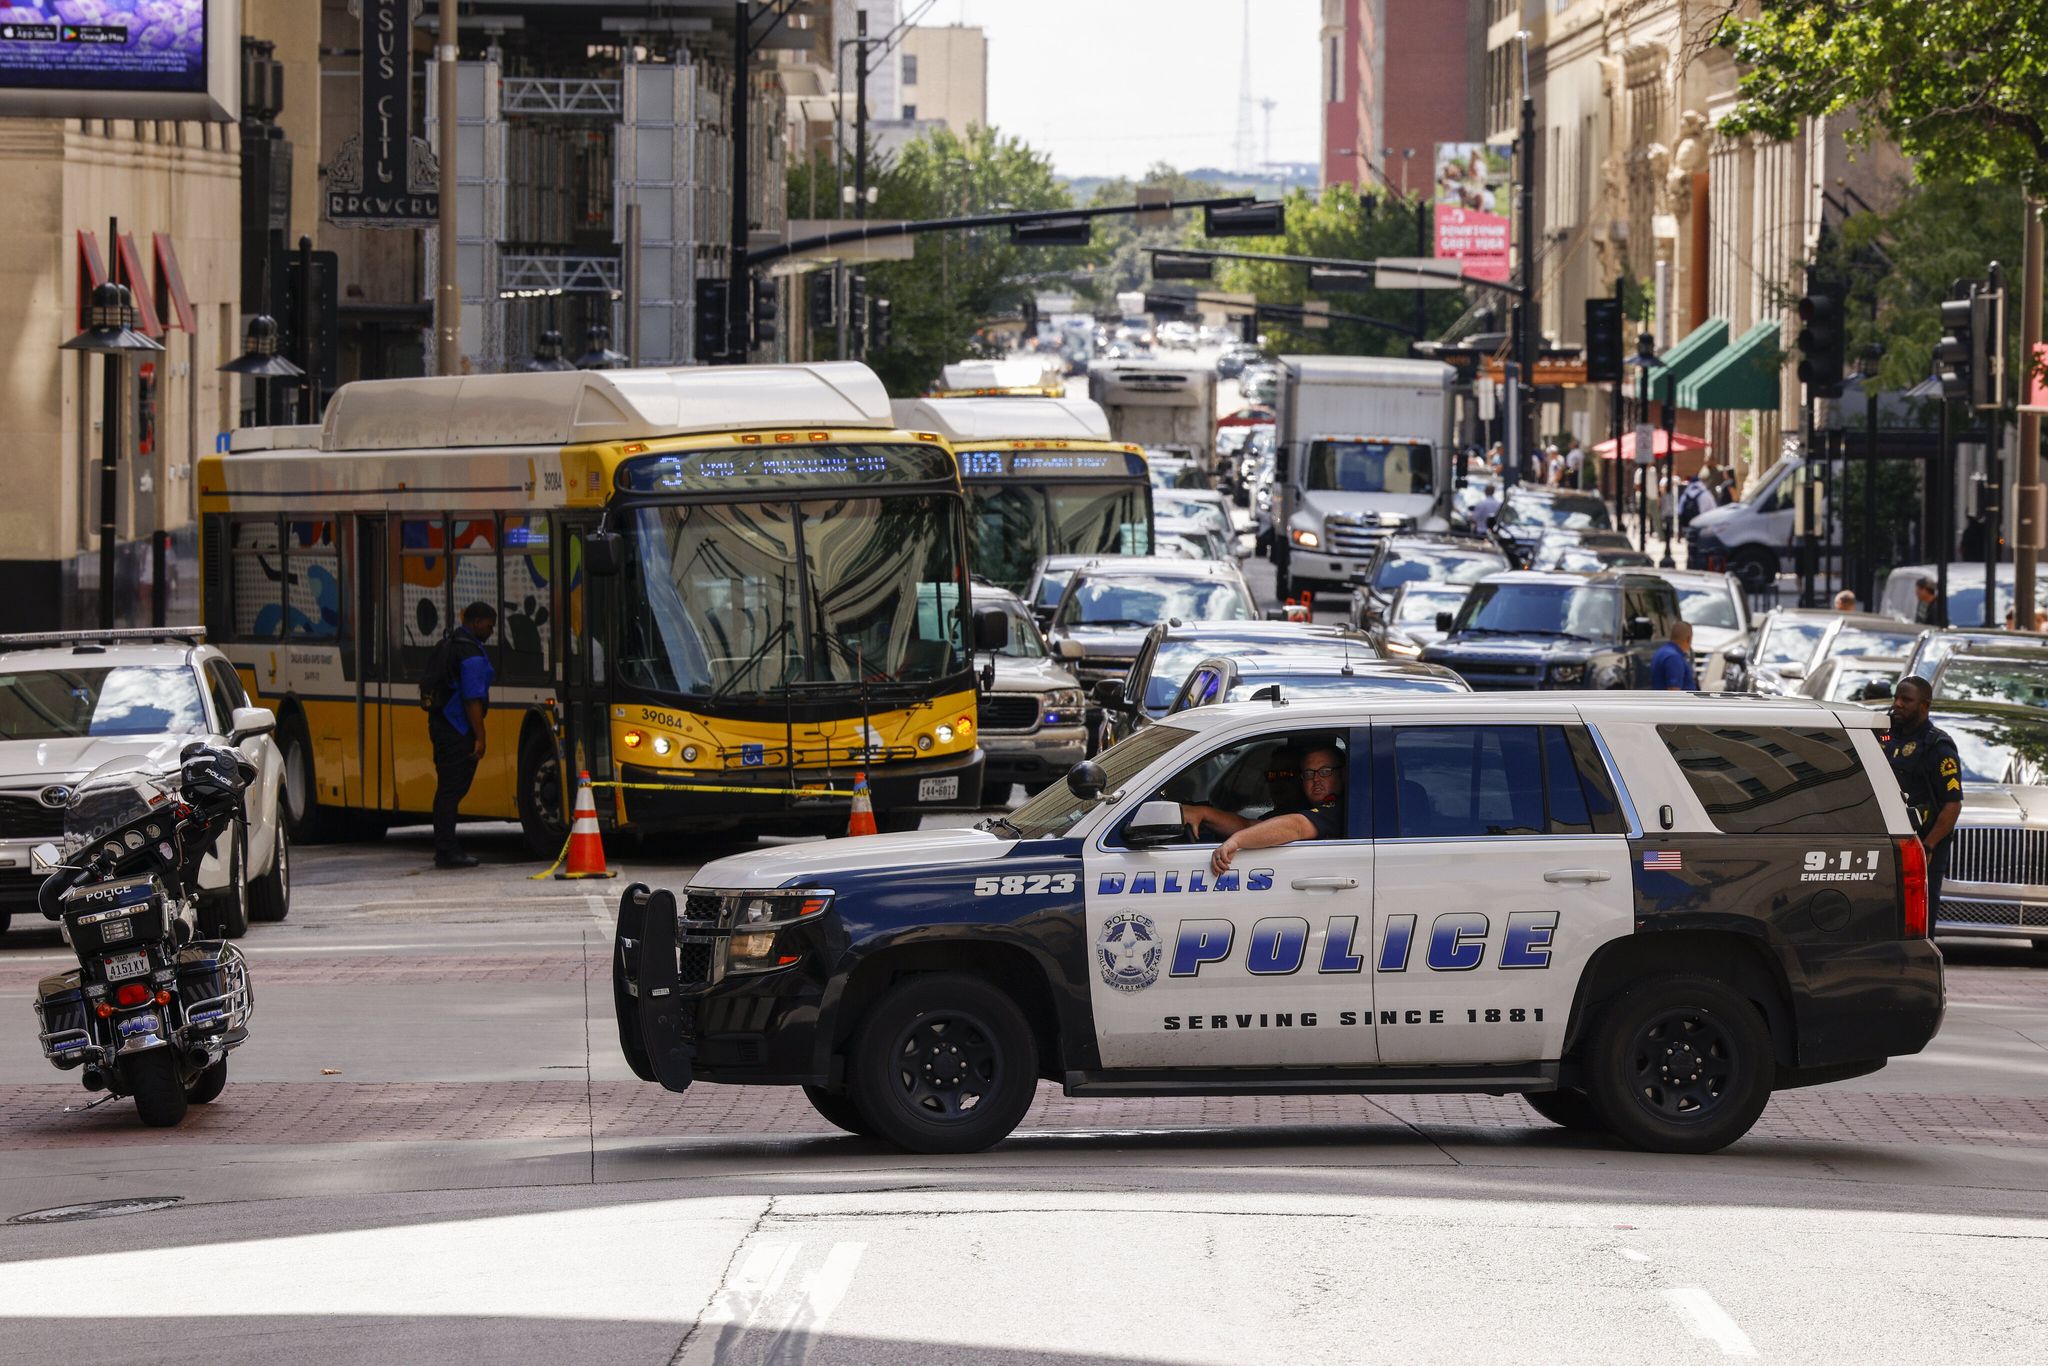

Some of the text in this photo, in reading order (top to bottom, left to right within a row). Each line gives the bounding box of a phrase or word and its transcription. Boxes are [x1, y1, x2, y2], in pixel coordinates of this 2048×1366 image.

[378, 0, 394, 79] SUS
[642, 707, 682, 729] 39084
[204, 768, 232, 786] POLICE
[973, 873, 1077, 897] 5823
[1098, 868, 1275, 895] DALLAS
[1800, 872, 1877, 882] EMERGENCY
[86, 885, 132, 902] POLICE
[1104, 913, 1153, 930] POLICE
[1168, 910, 1560, 978] POLICE
[110, 959, 145, 977] 4151XY
[1097, 949, 1116, 977] DALLAS
[1145, 948, 1162, 976] TEXAS
[1104, 976, 1155, 991] DEPARTMENT
[1164, 1007, 1544, 1031] SERVING SINCE 1881
